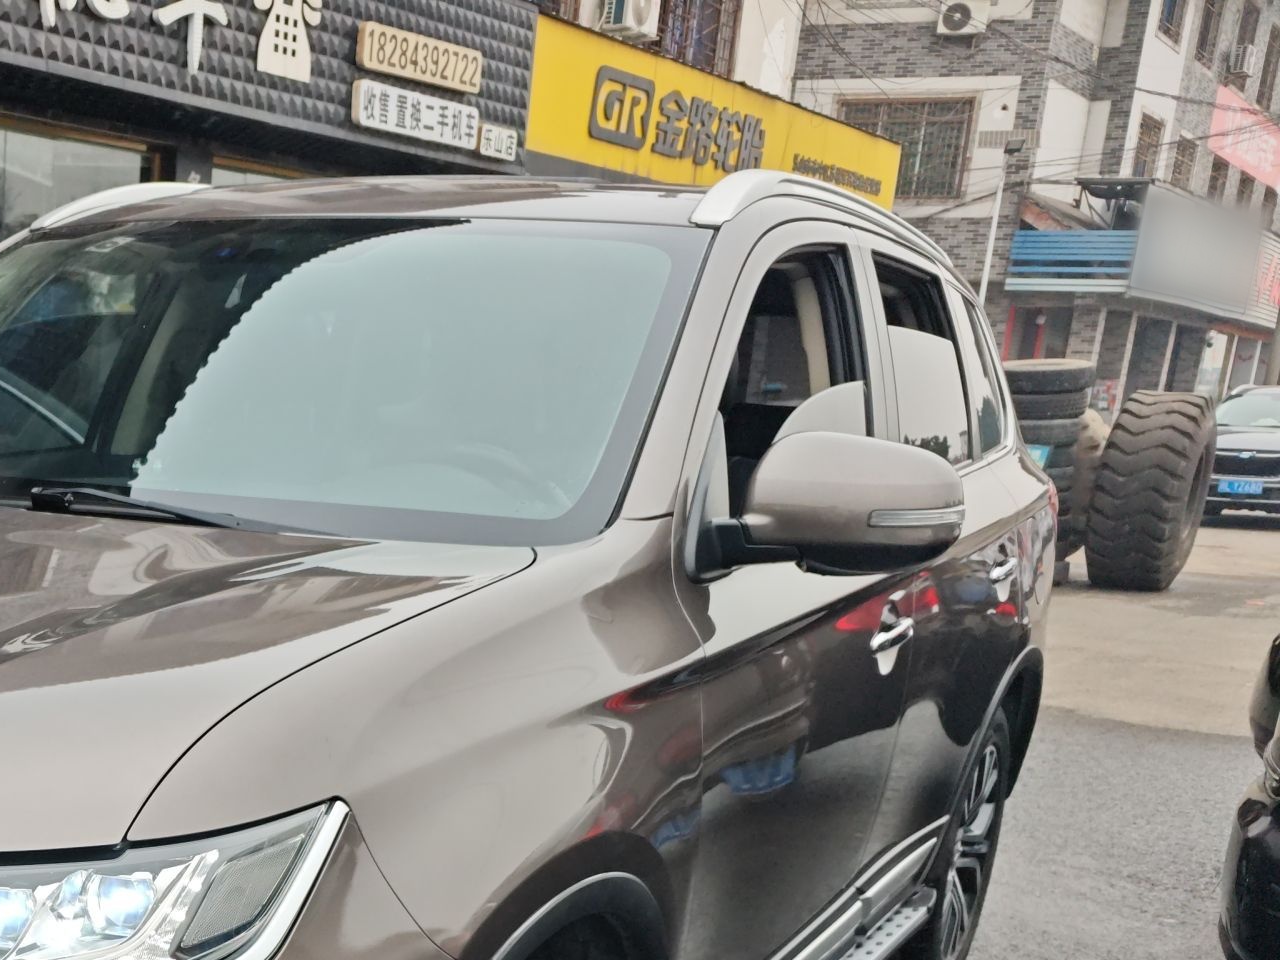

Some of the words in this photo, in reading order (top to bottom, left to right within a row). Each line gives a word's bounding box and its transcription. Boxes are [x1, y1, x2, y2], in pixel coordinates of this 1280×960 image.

[367, 28, 479, 88] 18284392722
[363, 85, 476, 145] 收售置换二手机车
[650, 89, 766, 173] 金路轮胎
